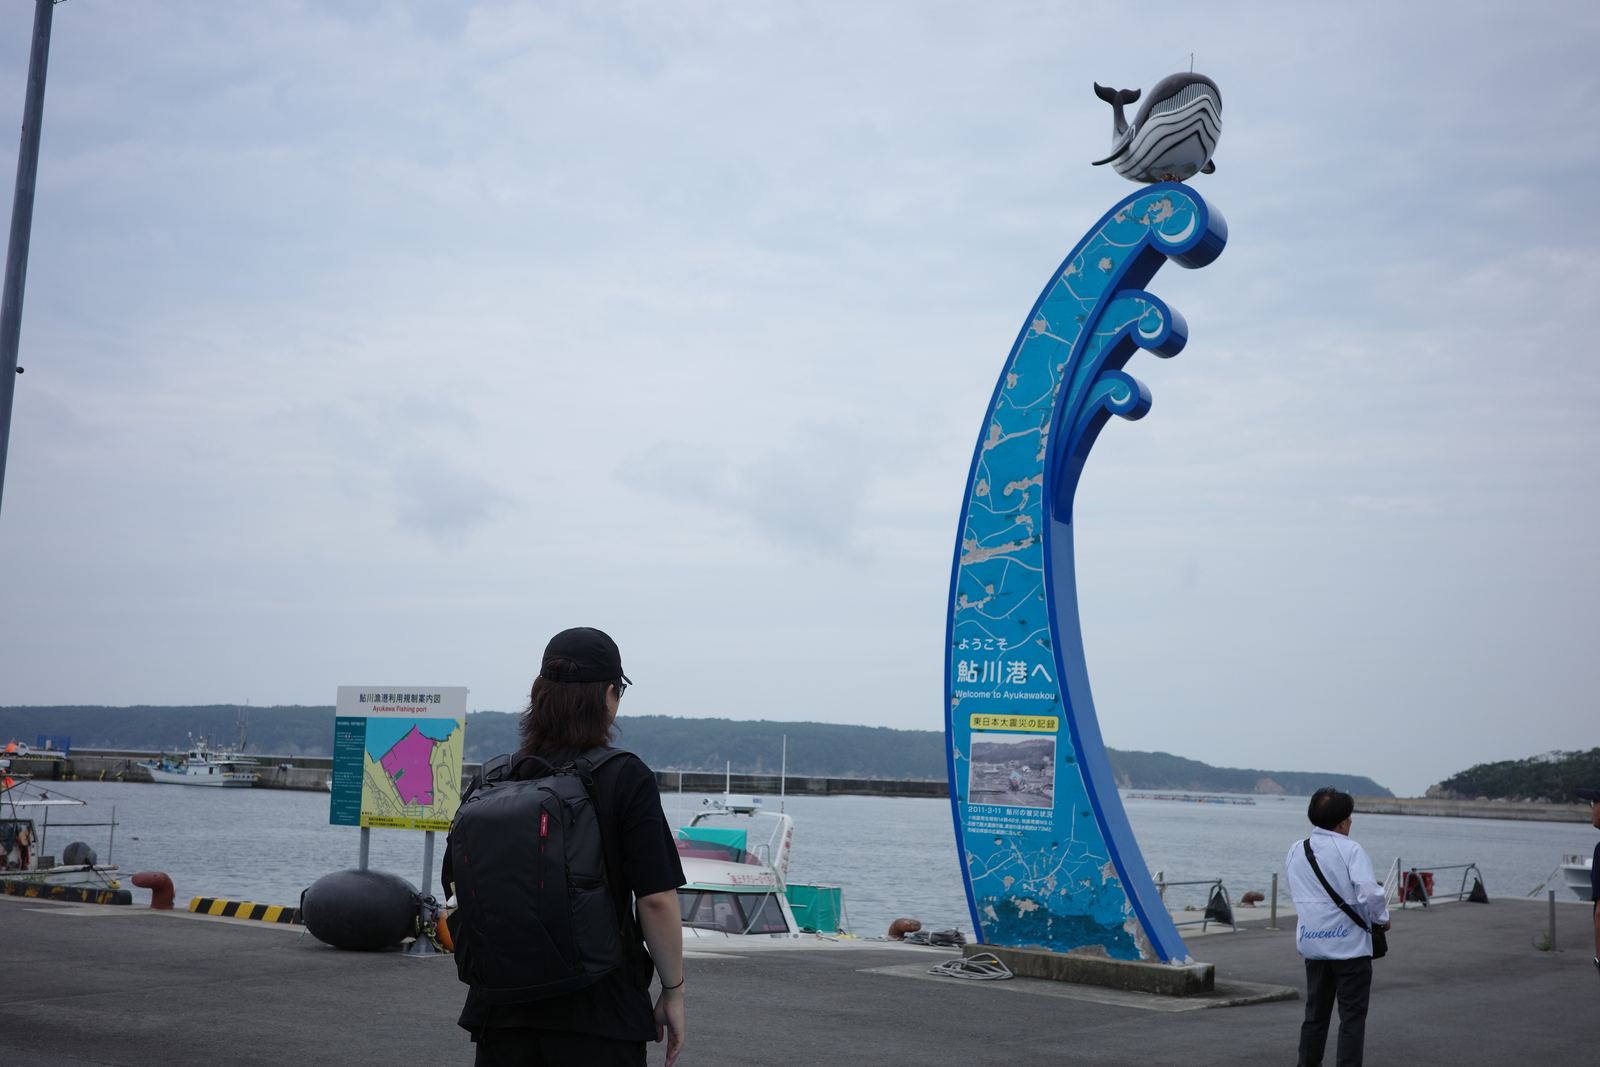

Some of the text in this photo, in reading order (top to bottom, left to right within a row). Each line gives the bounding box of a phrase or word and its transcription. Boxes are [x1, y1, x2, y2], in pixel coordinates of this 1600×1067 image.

[958, 638, 1008, 651] ようこそ
[956, 659, 1053, 684] 鮎川港へ
[955, 690, 1056, 700] Welcome to Ayukawakou
[396, 705, 416, 713] Fishing
[973, 717, 1056, 729] 東日本大震災の記録
[1299, 924, 1350, 942] Juvenile
